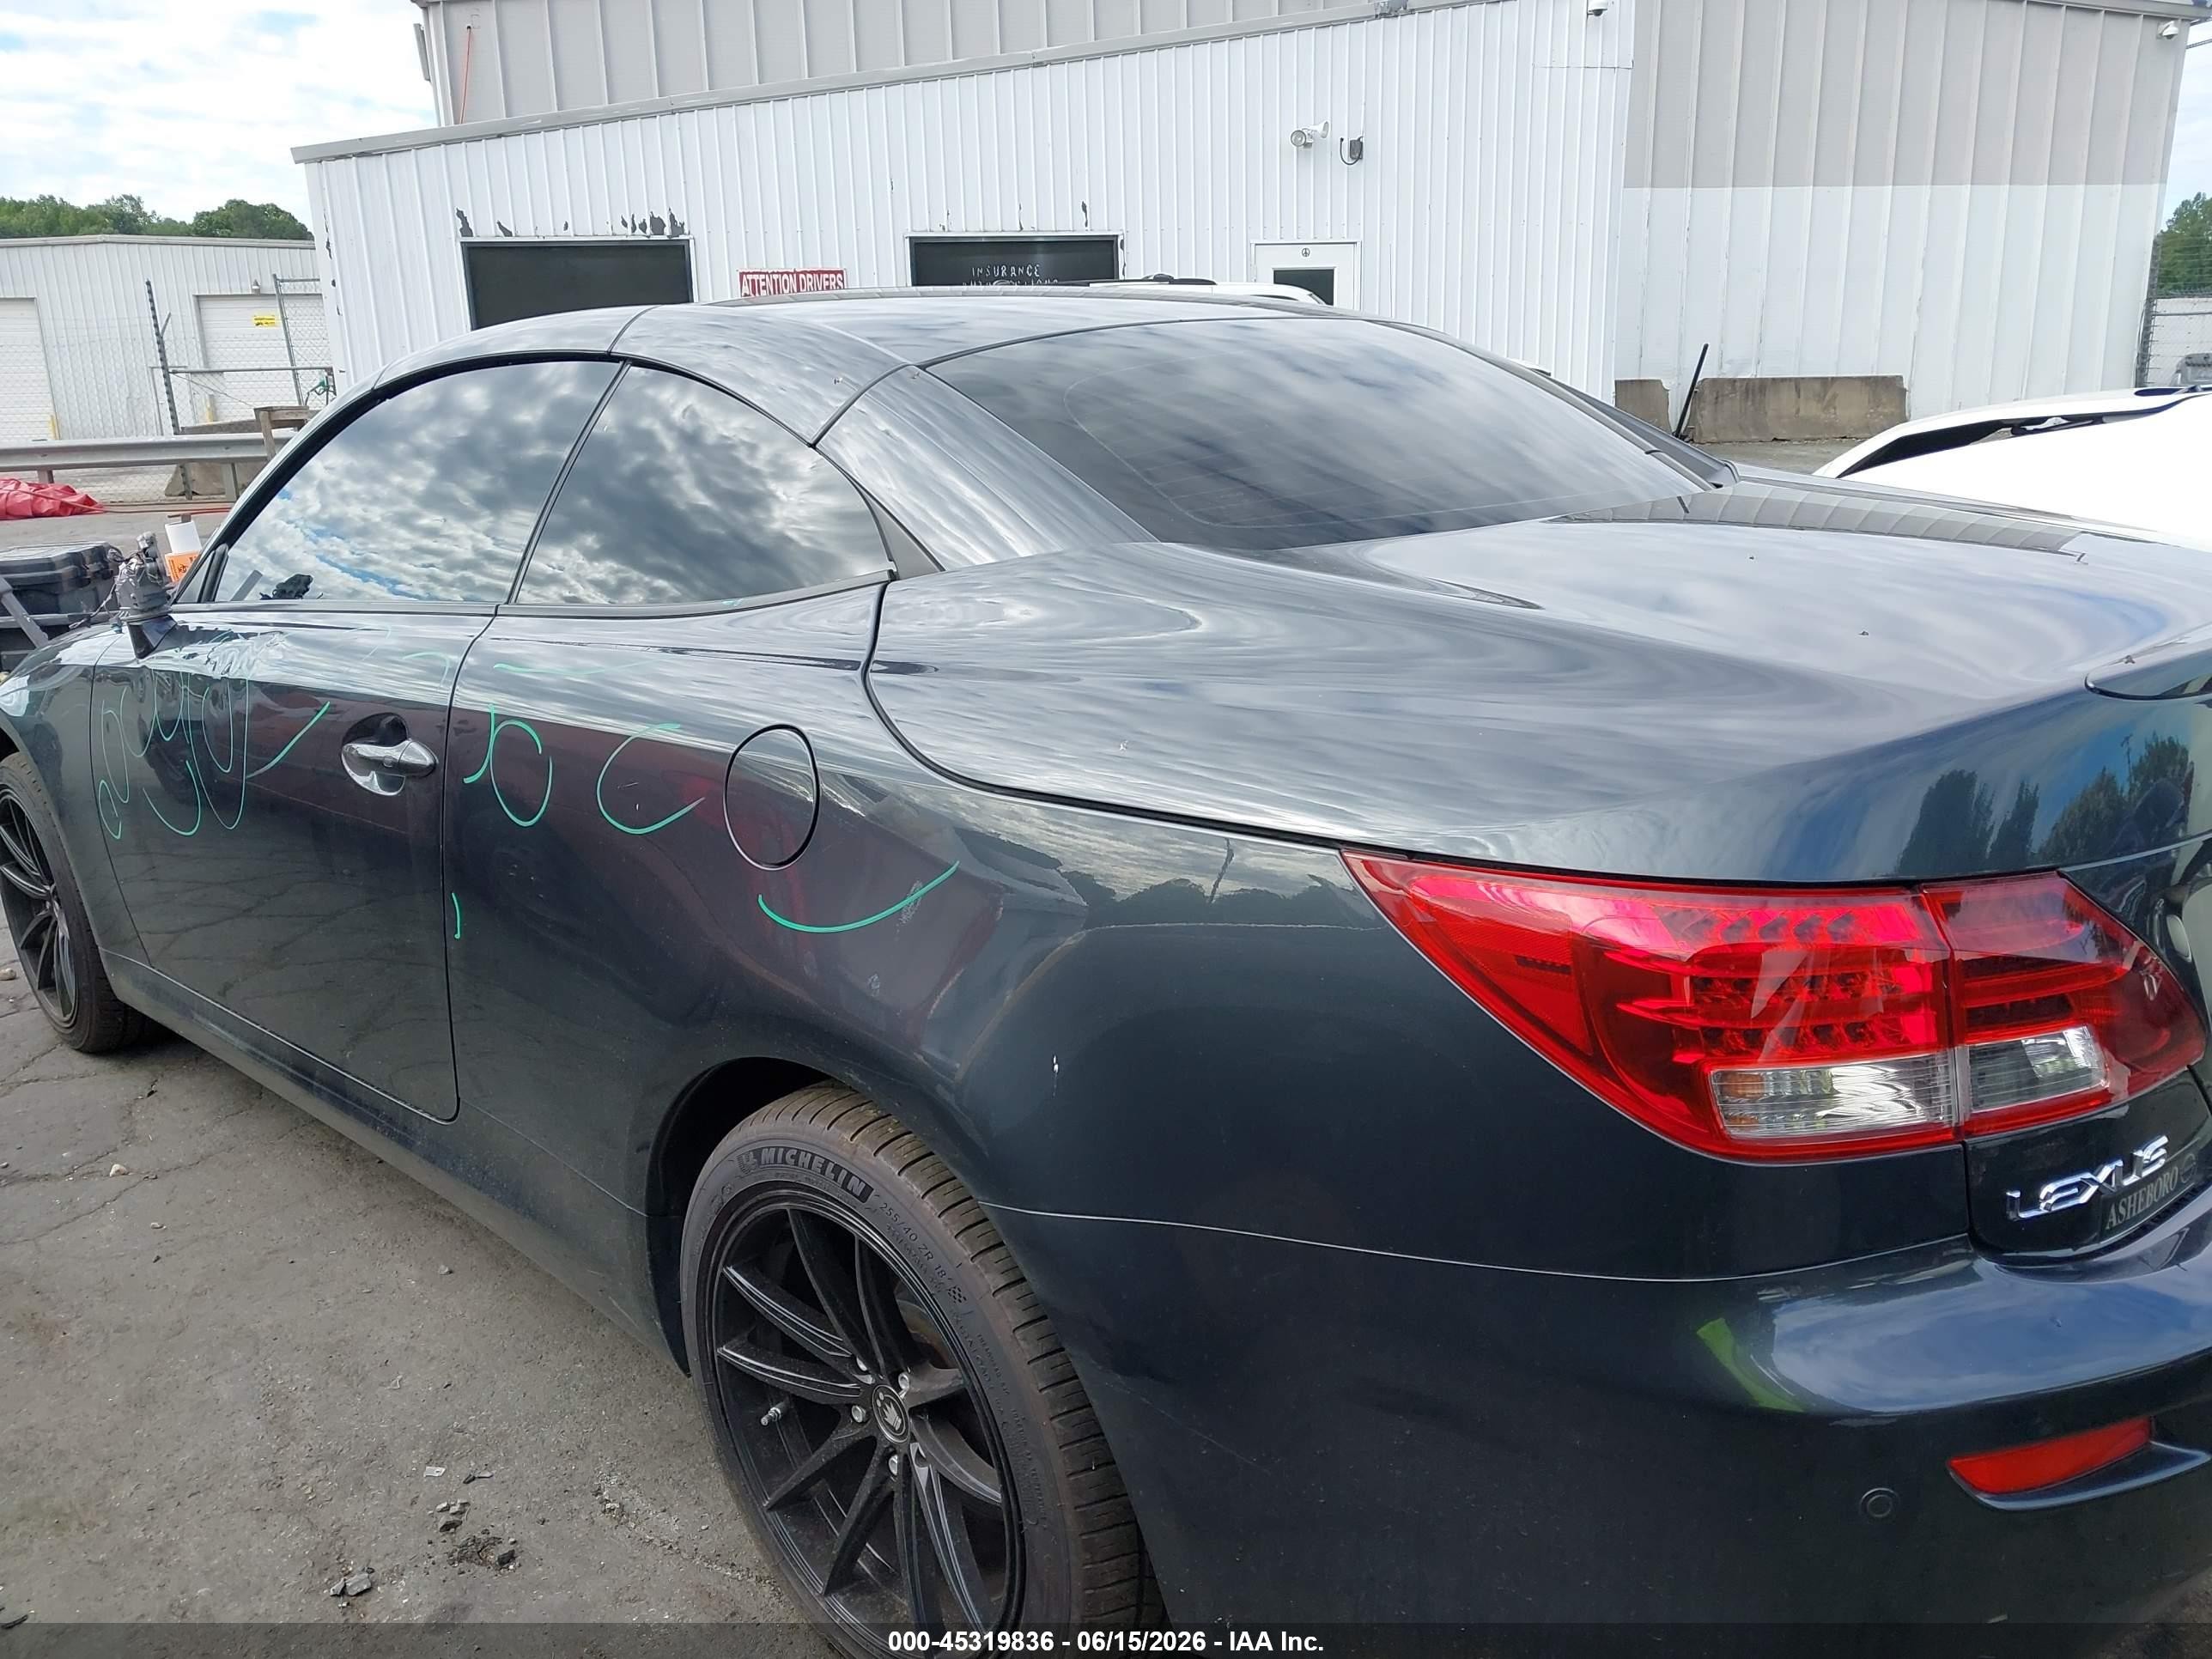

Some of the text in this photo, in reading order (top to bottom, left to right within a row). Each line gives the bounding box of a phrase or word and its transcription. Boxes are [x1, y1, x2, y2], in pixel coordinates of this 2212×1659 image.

[741, 272, 844, 297] ATTENTION DRIVERS
[971, 264, 1041, 276] INSURANCE
[761, 1147, 866, 1196] MICHELIN
[2006, 1135, 2169, 1221] LEXUS
[2105, 1166, 2179, 1230] ASHEBORO
[879, 1202, 918, 1242] 255/40
[918, 1243, 934, 1261] ZR
